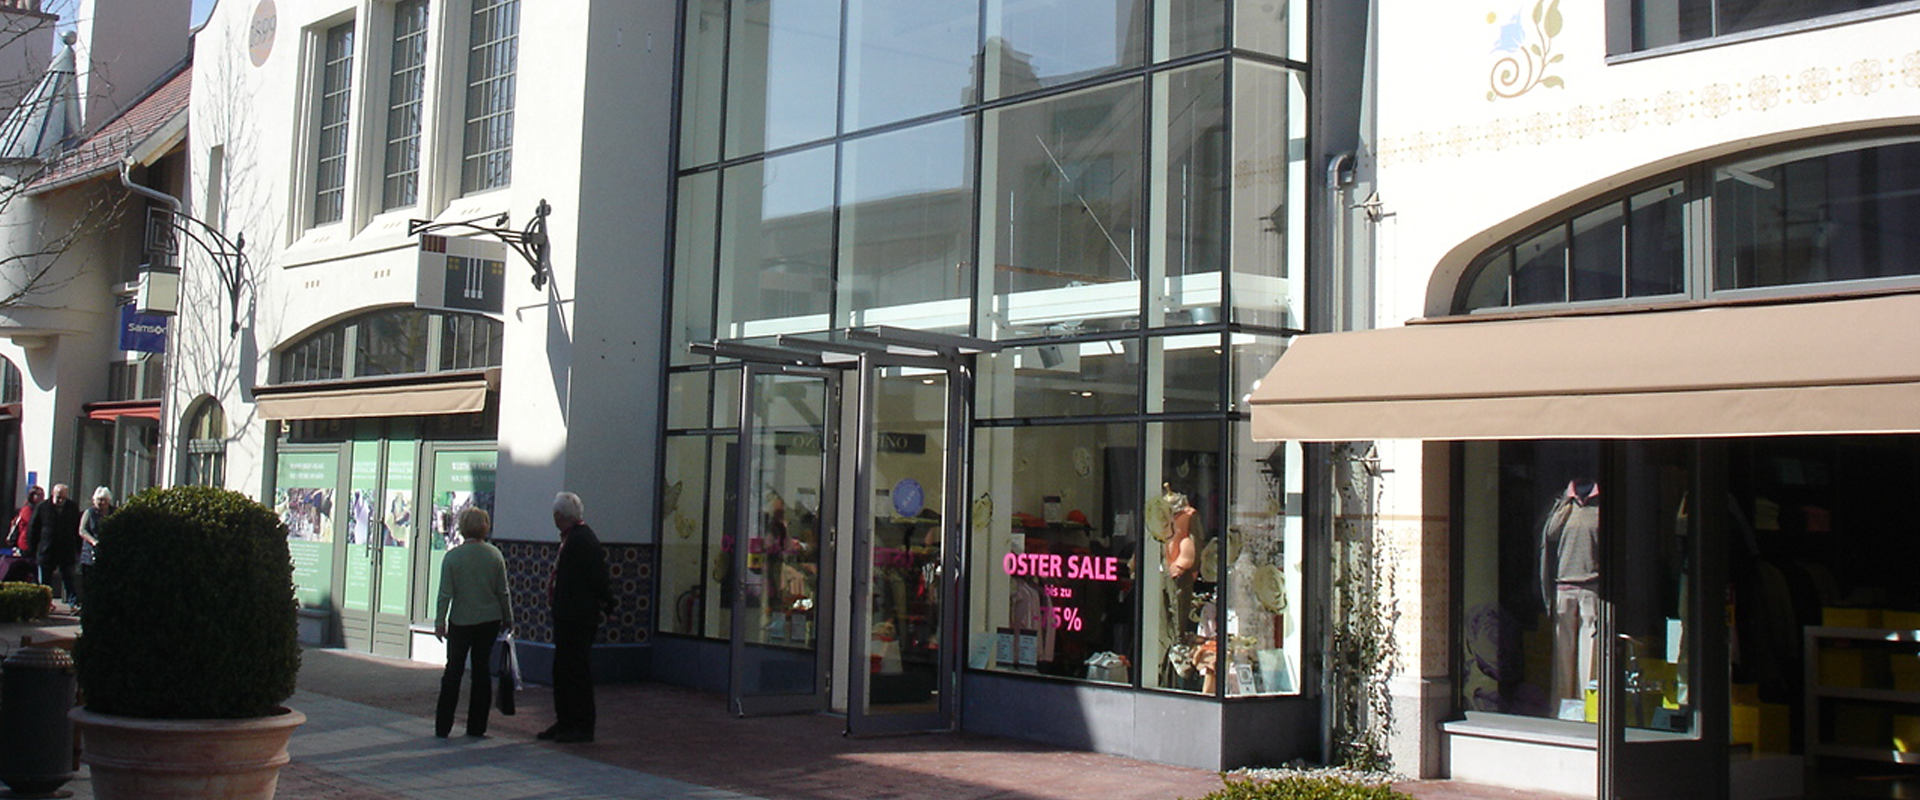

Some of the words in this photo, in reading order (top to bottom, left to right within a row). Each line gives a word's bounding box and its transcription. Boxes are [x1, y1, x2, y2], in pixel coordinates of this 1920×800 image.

[1003, 552, 1062, 578] OSTER
[1067, 555, 1118, 581] SALE
[1044, 584, 1059, 597] bis
[1060, 588, 1073, 598] zu
